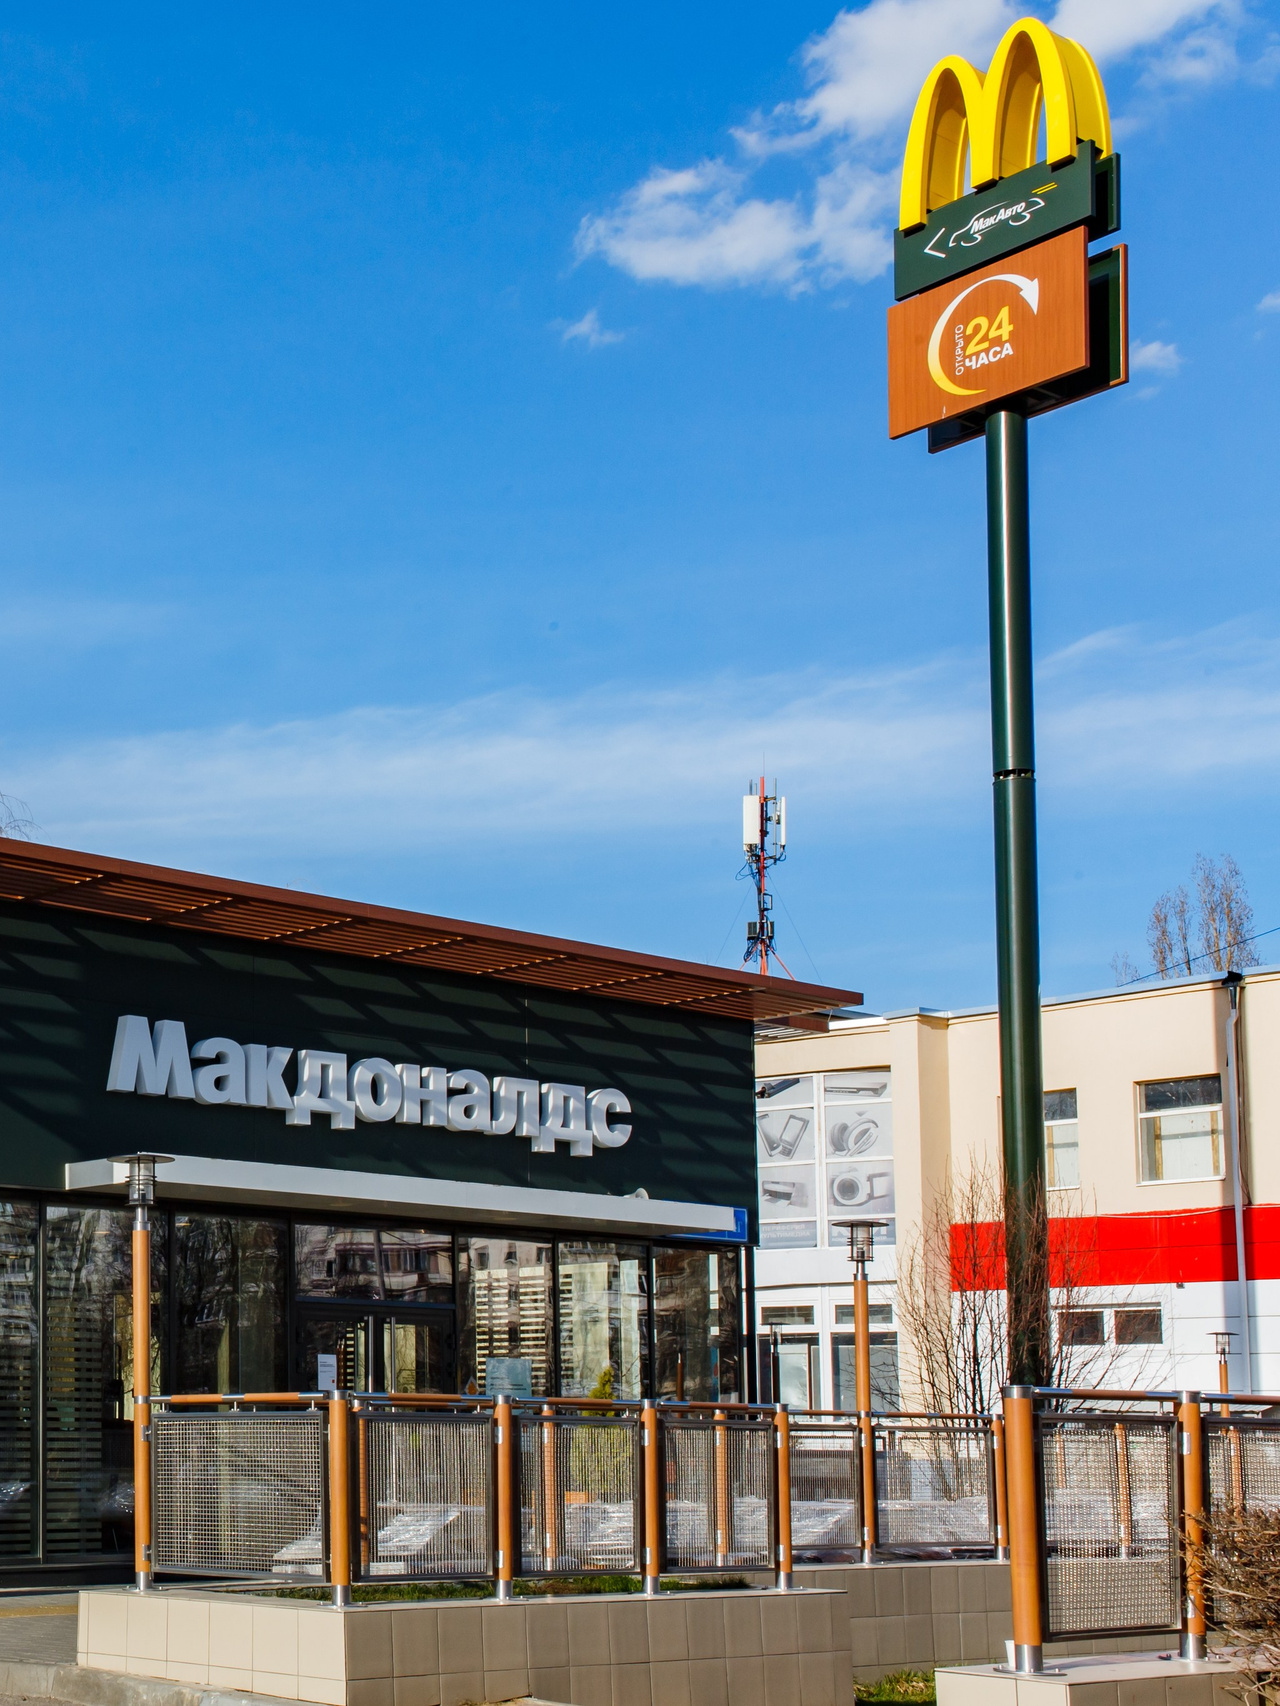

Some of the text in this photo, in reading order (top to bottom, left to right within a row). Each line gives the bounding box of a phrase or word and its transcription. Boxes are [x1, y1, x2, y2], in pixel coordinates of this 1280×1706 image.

[954, 324, 964, 376] ОТКРЫТО
[965, 305, 1014, 356] 24
[965, 342, 1014, 370] ЧАСА
[106, 1014, 632, 1158] Макдоналдс
[760, 1231, 811, 1239] УЛЬТИМЕДИА
